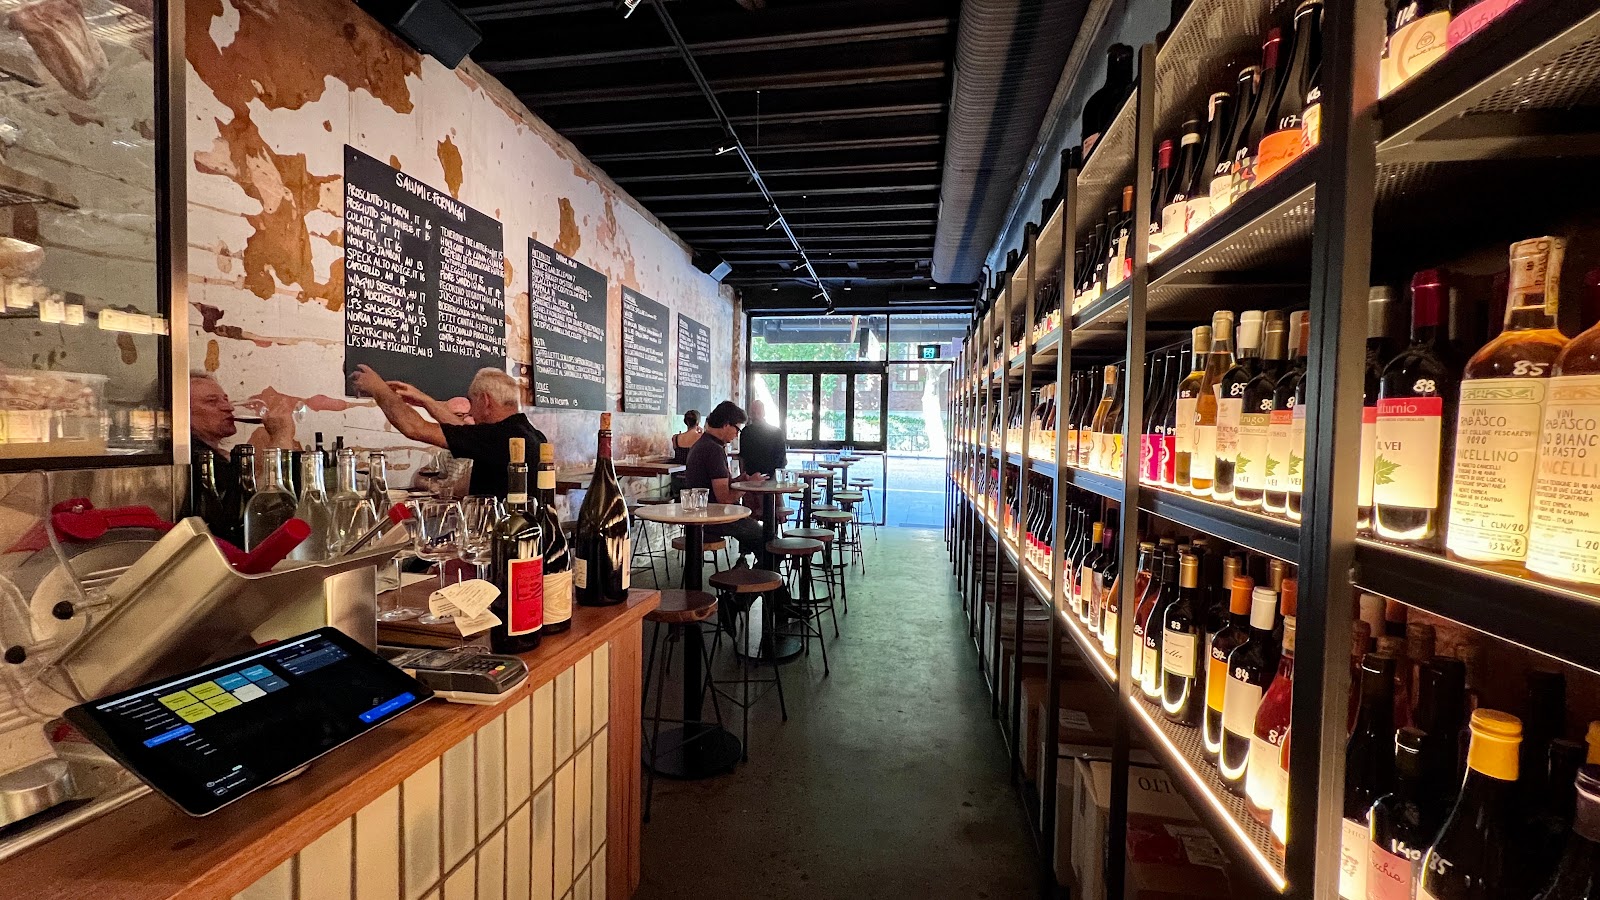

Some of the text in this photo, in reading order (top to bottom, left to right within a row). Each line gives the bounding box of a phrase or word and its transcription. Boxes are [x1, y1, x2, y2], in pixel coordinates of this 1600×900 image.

[1280, 115, 1301, 130] 117
[1215, 161, 1231, 175] 109
[396, 173, 426, 200] SALUMI
[1173, 194, 1184, 204] 110
[347, 183, 383, 207] PROSCIUTTO
[384, 200, 390, 211] DI
[415, 215, 420, 224] IT
[425, 219, 432, 230] 16
[347, 196, 378, 218] PROSCIUTTO
[380, 212, 392, 224] SAN
[381, 224, 387, 233] IT
[384, 238, 393, 248] IT
[395, 241, 402, 252] 16
[347, 248, 372, 264] SPECK
[373, 258, 390, 269] ALTO
[412, 270, 418, 279] IT
[420, 273, 425, 281] 16
[405, 257, 413, 267] AU
[417, 261, 423, 270] 13
[385, 272, 394, 280] AU
[348, 274, 374, 288] WAGYU
[420, 293, 425, 303] 17
[406, 302, 414, 311] AU
[408, 314, 416, 324] AU
[419, 317, 428, 327] 13
[438, 311, 456, 323] PETIT
[400, 322, 409, 332] AU
[414, 326, 421, 336] 12
[401, 334, 409, 343] AU
[413, 336, 419, 345] 17
[362, 336, 386, 350] SALAME
[417, 348, 426, 356] AU
[427, 348, 433, 358] 13
[439, 341, 451, 352] BLU
[1513, 360, 1549, 377] 85
[536, 382, 549, 390] DOLCE
[1230, 383, 1247, 396] 85
[1413, 378, 1435, 393] 88
[1286, 396, 1295, 408] 8
[1472, 408, 1486, 416] VINI
[1557, 410, 1573, 418] VINI
[1385, 442, 1402, 451] VEI
[1552, 447, 1586, 458] PASTO
[1491, 522, 1524, 532] CLN/20
[1171, 621, 1181, 630] 83
[1146, 637, 1155, 647] 86
[1212, 647, 1226, 660] 84
[1235, 667, 1249, 682] 84
[1391, 838, 1421, 860] 140
[1429, 852, 1453, 875] 85
